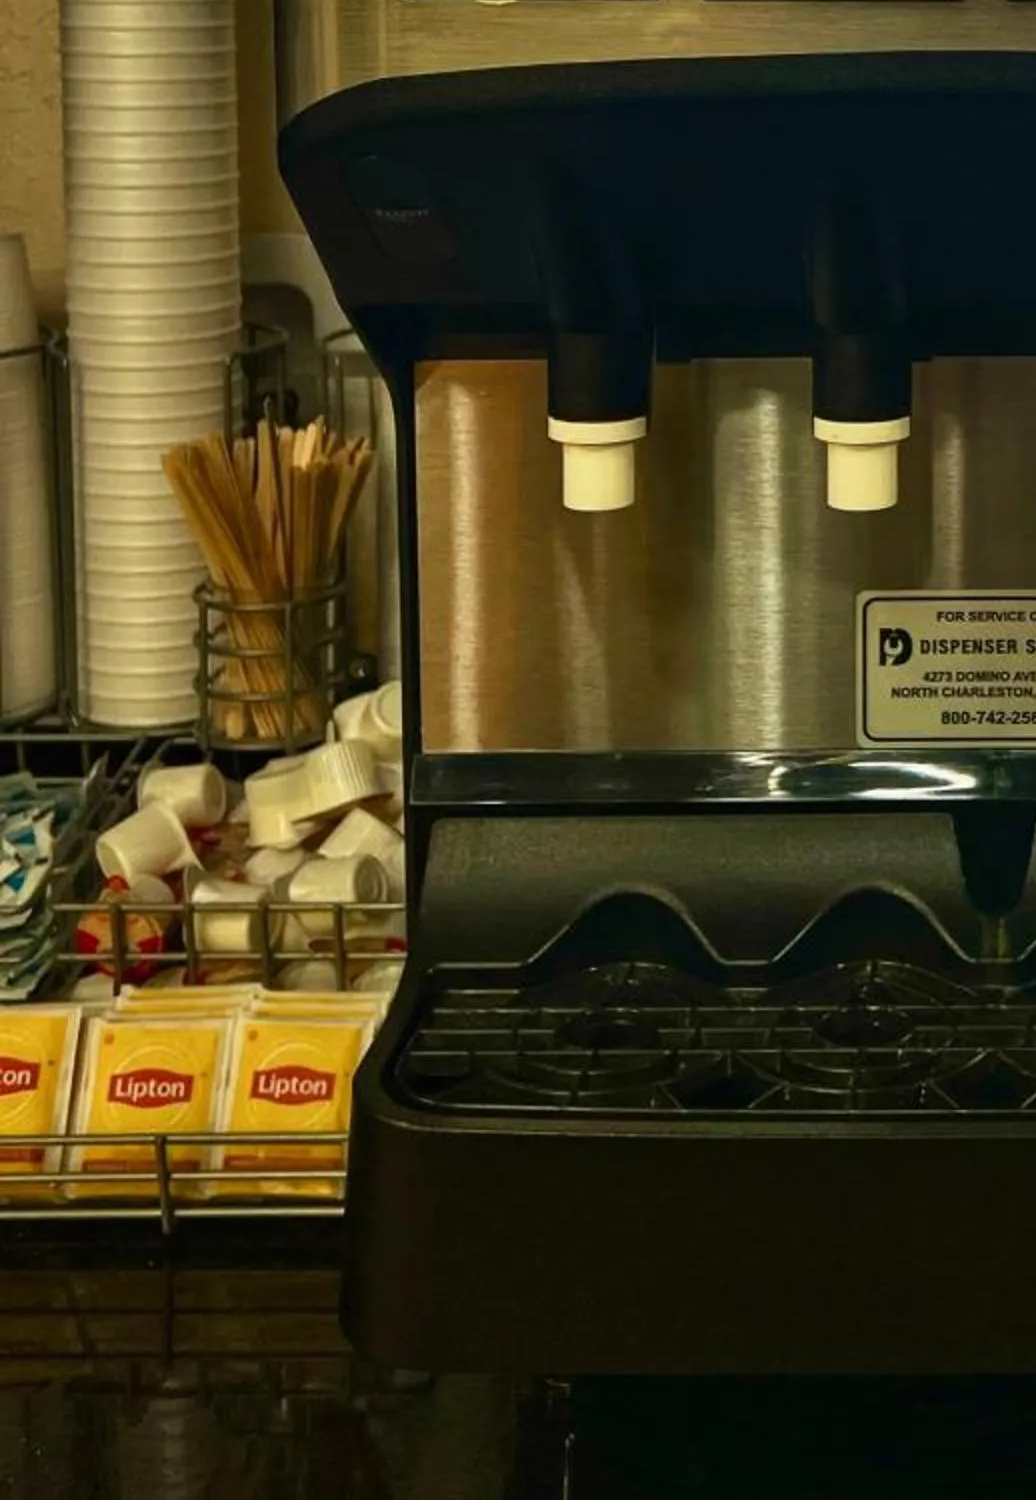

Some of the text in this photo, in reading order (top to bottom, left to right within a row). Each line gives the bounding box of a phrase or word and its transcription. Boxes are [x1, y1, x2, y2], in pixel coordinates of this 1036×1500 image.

[937, 610, 966, 622] FOR
[968, 610, 1026, 623] SERVICE
[920, 638, 1018, 655] DISPENSER
[956, 670, 1010, 683] DOMINO
[891, 687, 939, 699] NORTH
[942, 686, 1036, 700] CHARLESTON,
[0, 1069, 31, 1086] on
[258, 1073, 327, 1098] Lipton
[116, 1077, 185, 1101] Lipton
